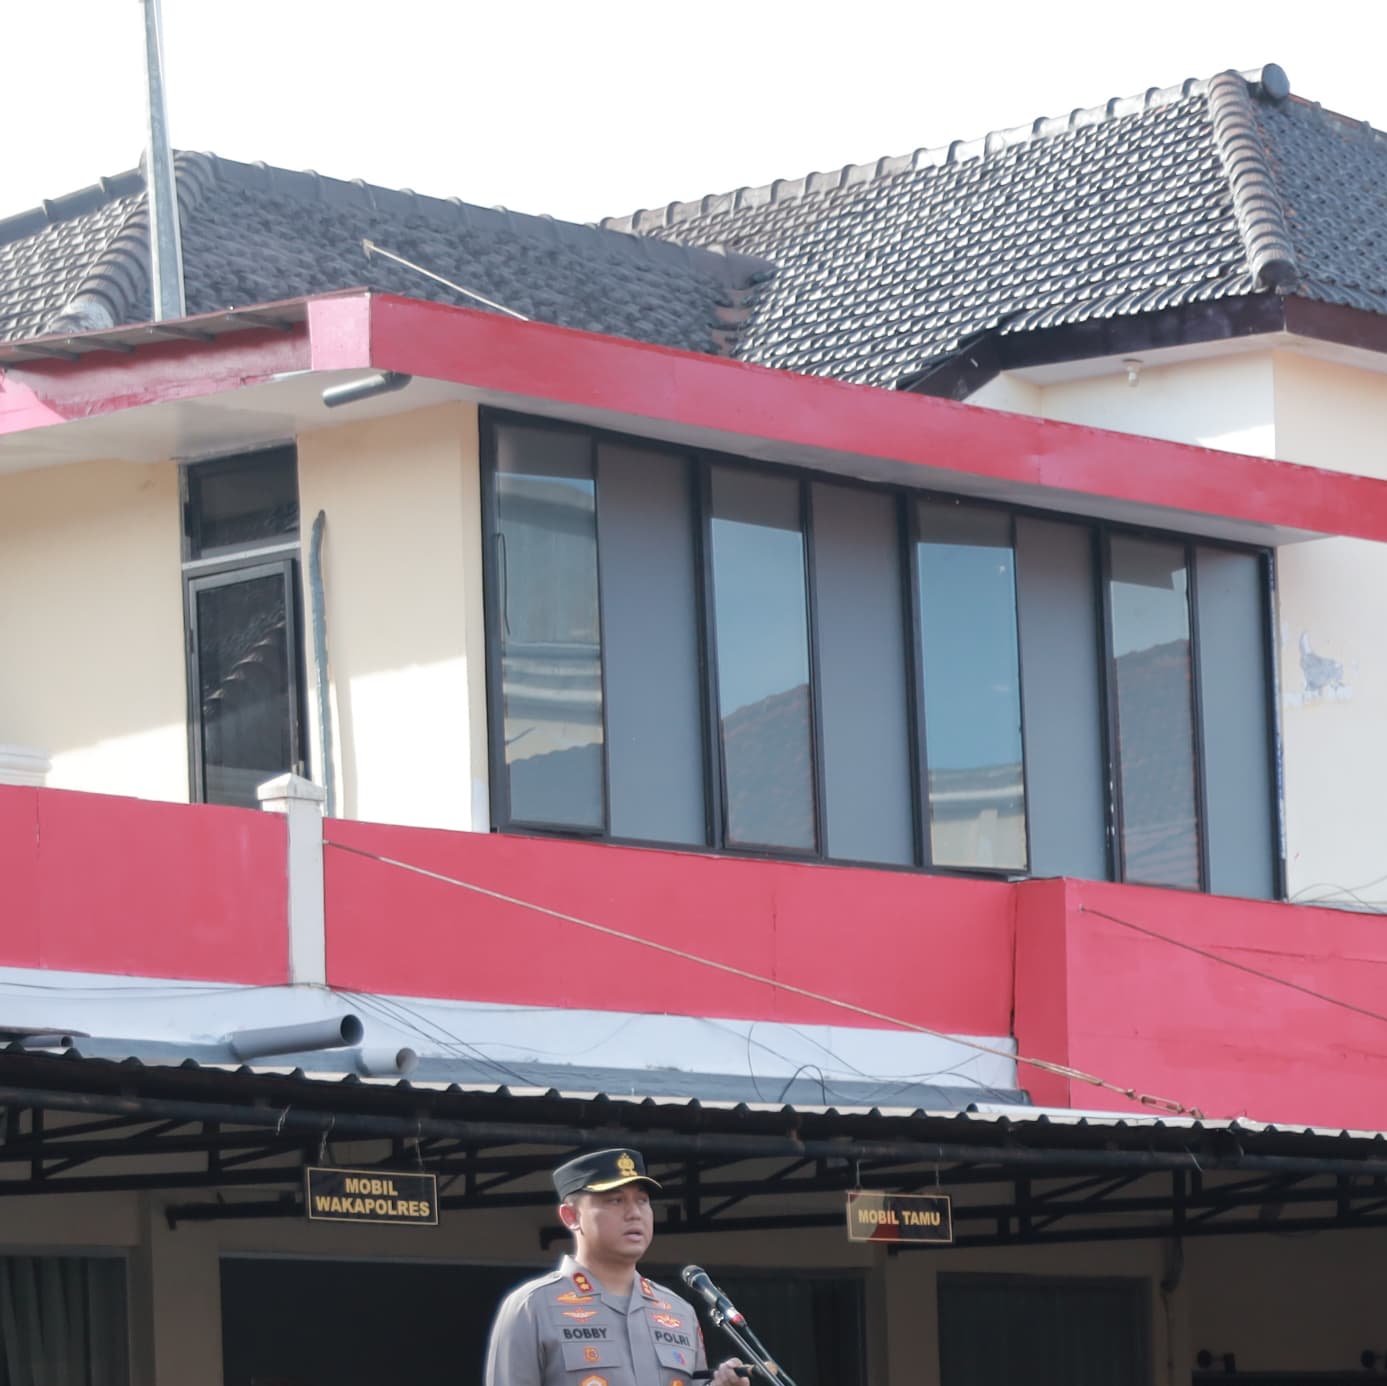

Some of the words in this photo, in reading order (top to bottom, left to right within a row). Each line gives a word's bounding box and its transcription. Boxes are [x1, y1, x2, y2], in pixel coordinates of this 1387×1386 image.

[344, 1177, 398, 1196] MOBIL
[315, 1195, 431, 1217] WAKAPOLRES
[858, 1209, 900, 1225] MOBIL
[902, 1210, 941, 1226] TAMU
[562, 1327, 607, 1340] BOBBY
[654, 1330, 690, 1347] POLRI
